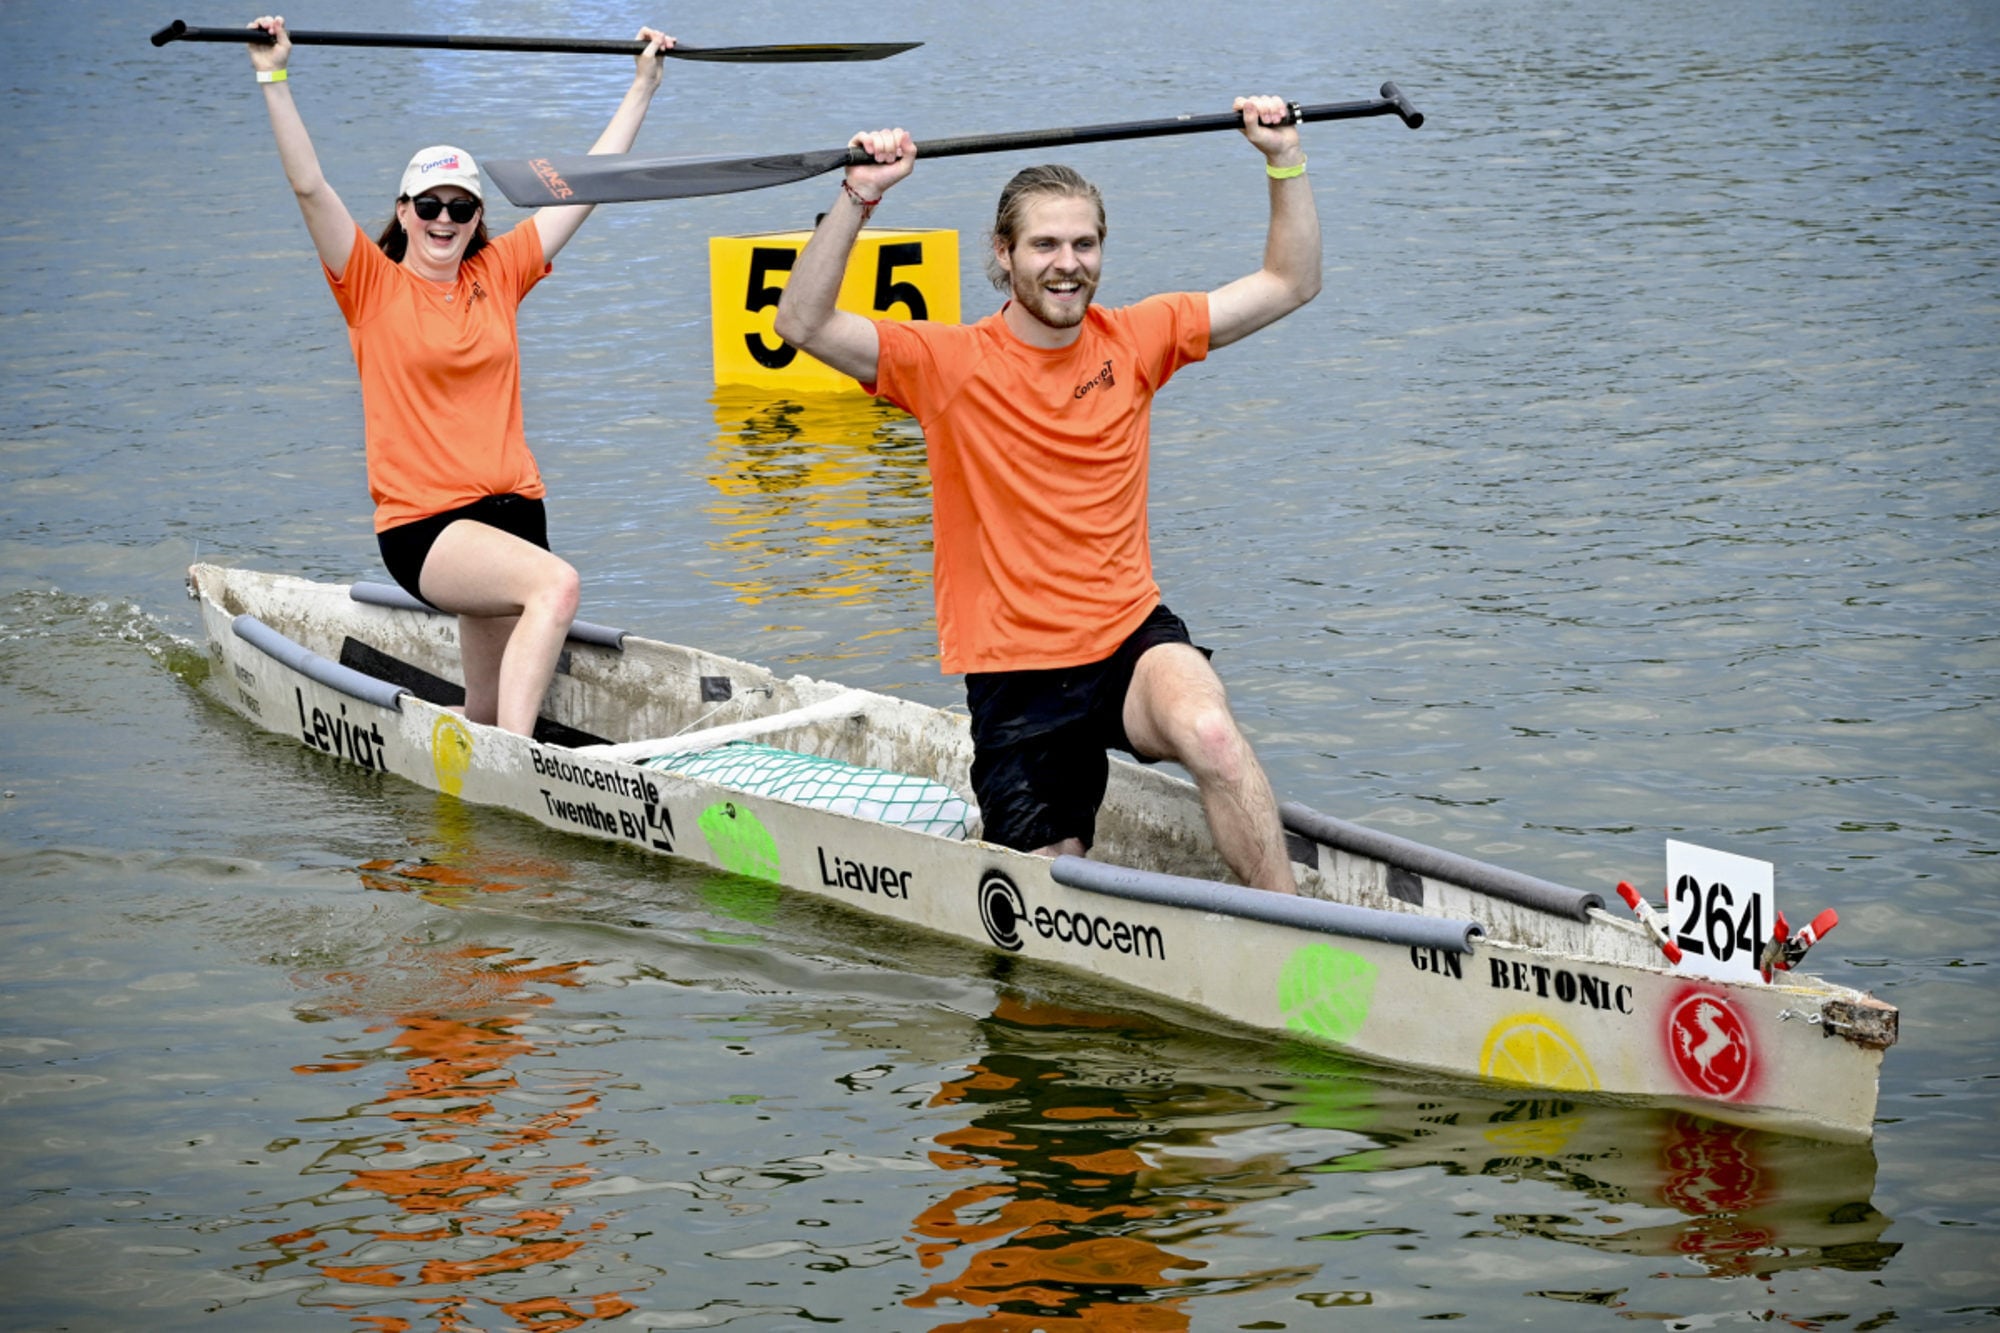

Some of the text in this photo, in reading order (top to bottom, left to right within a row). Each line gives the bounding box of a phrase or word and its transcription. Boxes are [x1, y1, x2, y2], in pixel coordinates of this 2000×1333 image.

[745, 247, 798, 369] 5
[873, 242, 928, 320] 5
[296, 687, 388, 772] Leviat
[530, 748, 660, 804] Betoncentrale
[540, 789, 647, 842] Twenthe BV
[818, 846, 912, 899] Liaver
[1034, 905, 1166, 960] ecocem
[1676, 874, 1767, 971] 264
[1410, 945, 1634, 1015] GIN BETONIC
